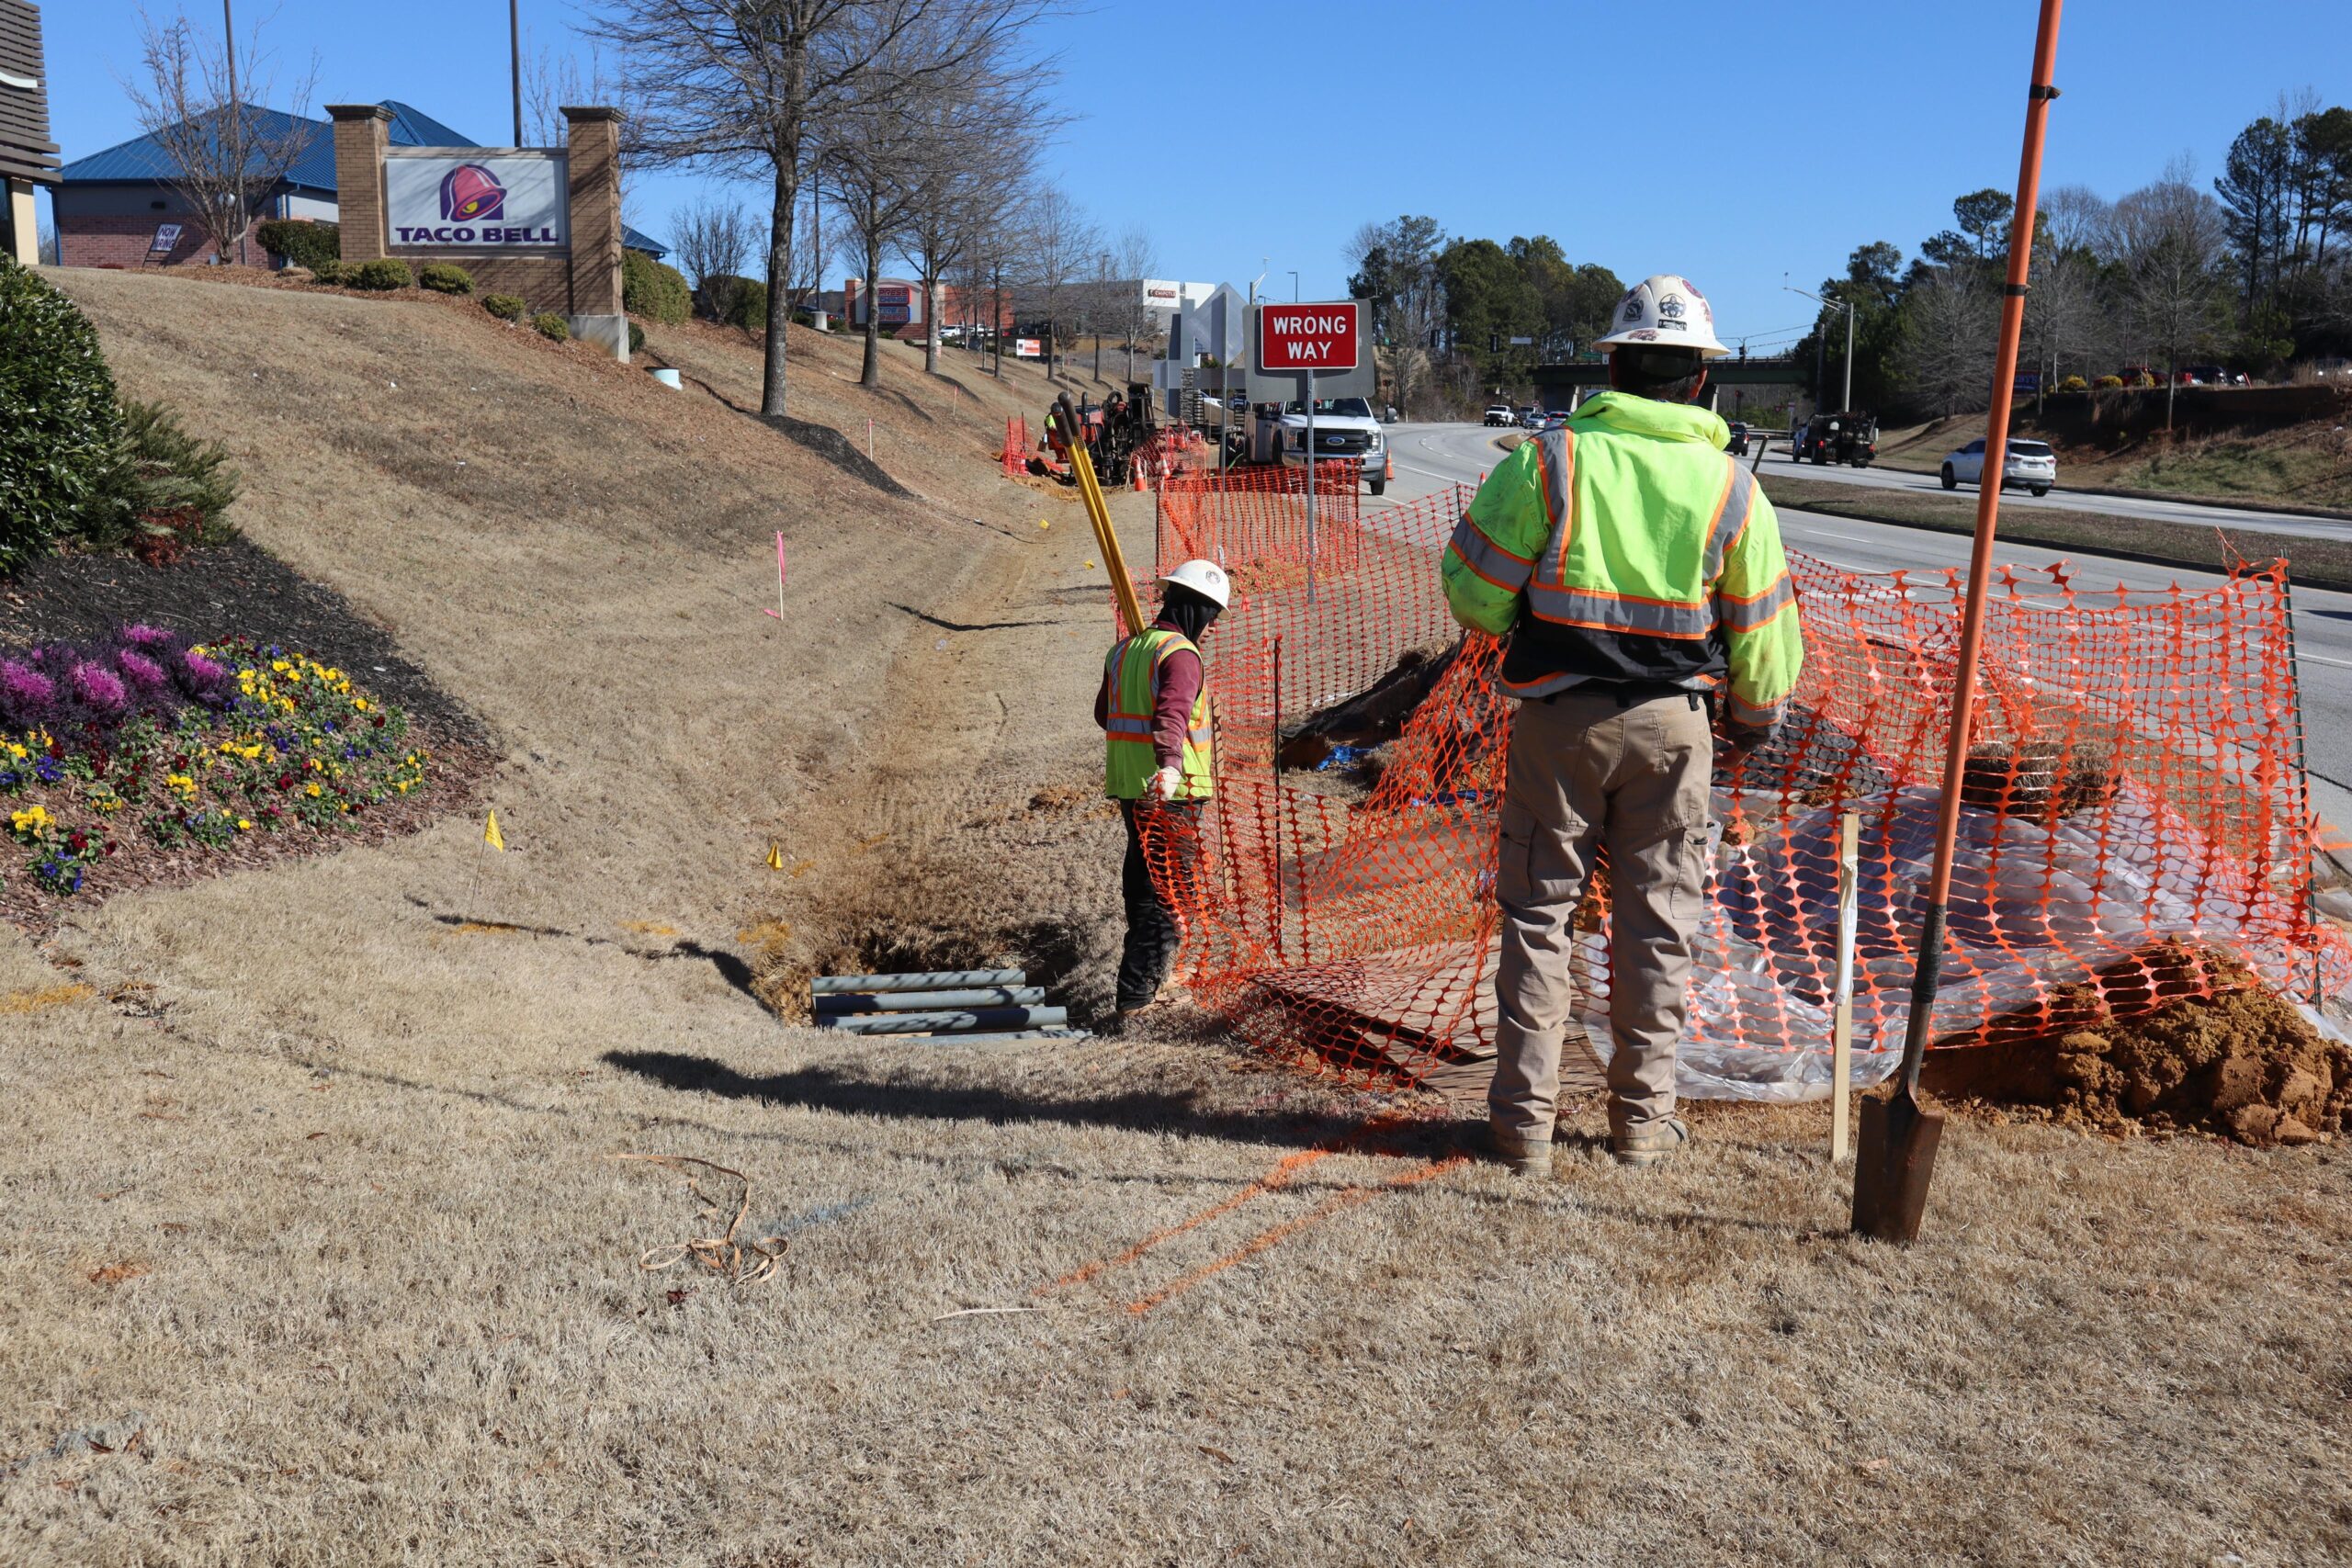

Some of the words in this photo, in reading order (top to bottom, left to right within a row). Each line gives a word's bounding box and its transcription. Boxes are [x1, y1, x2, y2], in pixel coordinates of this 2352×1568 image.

[159, 227, 178, 237] NOW
[395, 227, 475, 243] TACO
[482, 227, 560, 243] BELL
[1272, 316, 1347, 334] WRONG
[1287, 341, 1332, 359] WAY
